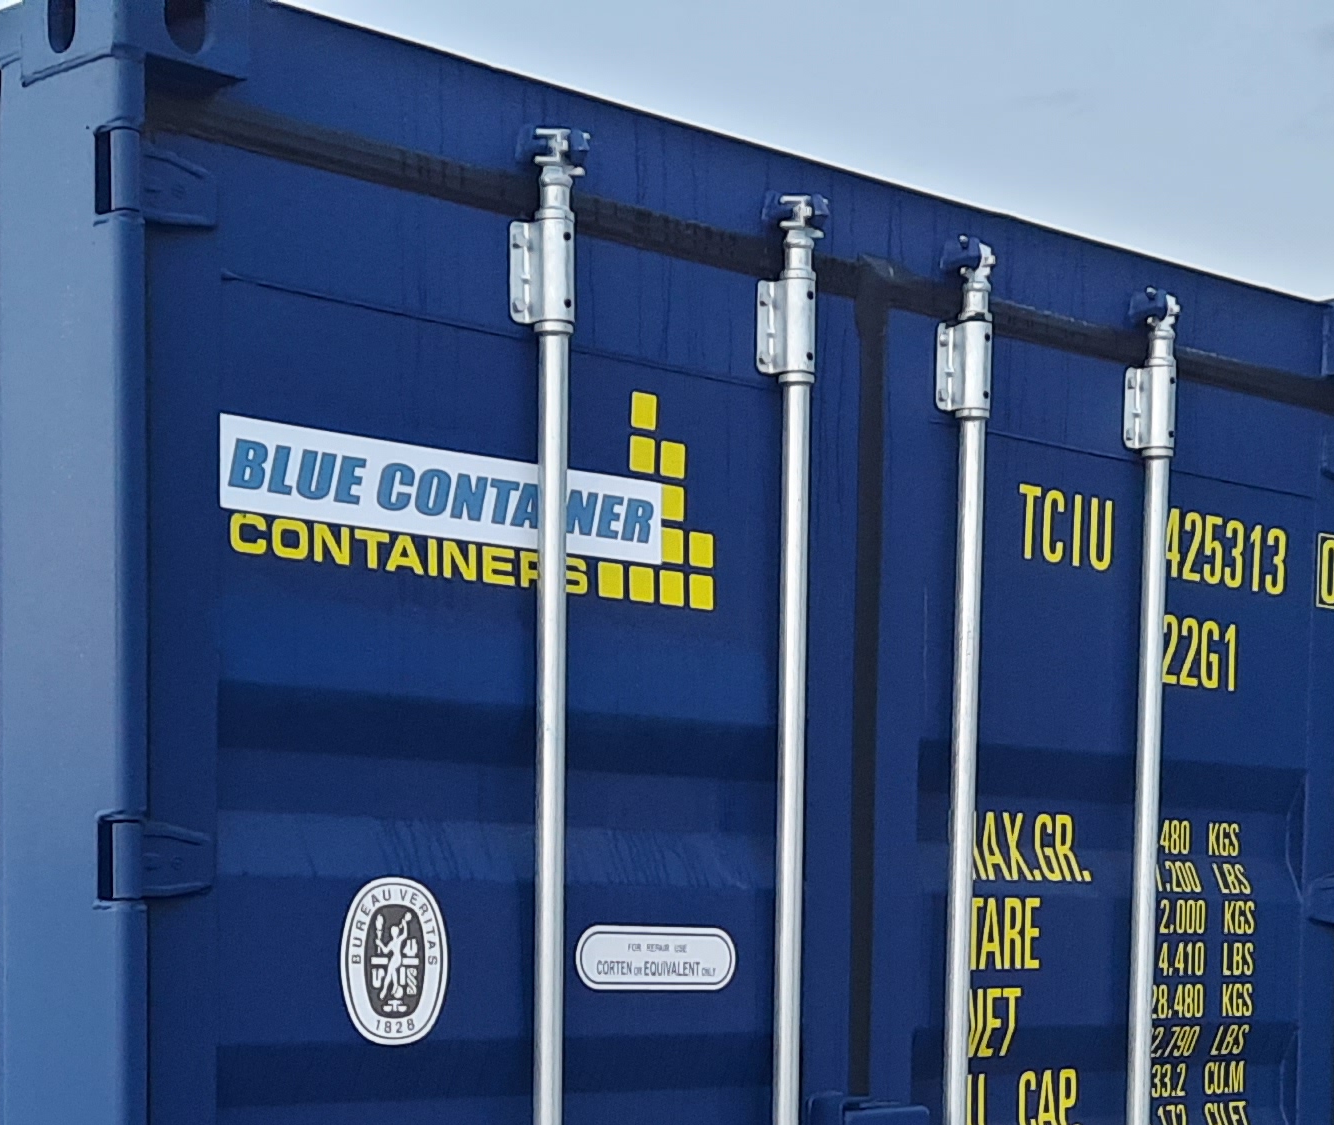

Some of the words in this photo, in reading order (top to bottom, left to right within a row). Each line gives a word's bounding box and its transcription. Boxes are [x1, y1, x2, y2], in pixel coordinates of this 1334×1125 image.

[228, 438, 367, 505] BLUE
[377, 462, 655, 545] CONTANER
[1019, 483, 1115, 572] TCIU
[1165, 508, 1288, 596] 425313
[1161, 614, 1237, 691] 22G1
[1159, 819, 1192, 855] 480
[1208, 822, 1241, 857] KGS
[1211, 862, 1252, 895] LBS
[351, 889, 392, 965] BUREAU
[398, 888, 438, 966] VERITAS
[969, 896, 1042, 970] TARE
[1224, 900, 1257, 935] KGS
[627, 943, 642, 952] FOR
[1222, 942, 1255, 977] LBS
[596, 959, 633, 976] CORTEN
[643, 961, 701, 977] EQUIVALENT
[1222, 983, 1253, 1017] KGS
[374, 1018, 416, 1034] 1828
[1210, 1024, 1250, 1056] LBS
[1150, 1062, 1187, 1098] 33.2
[1204, 1061, 1246, 1095] CU.M
